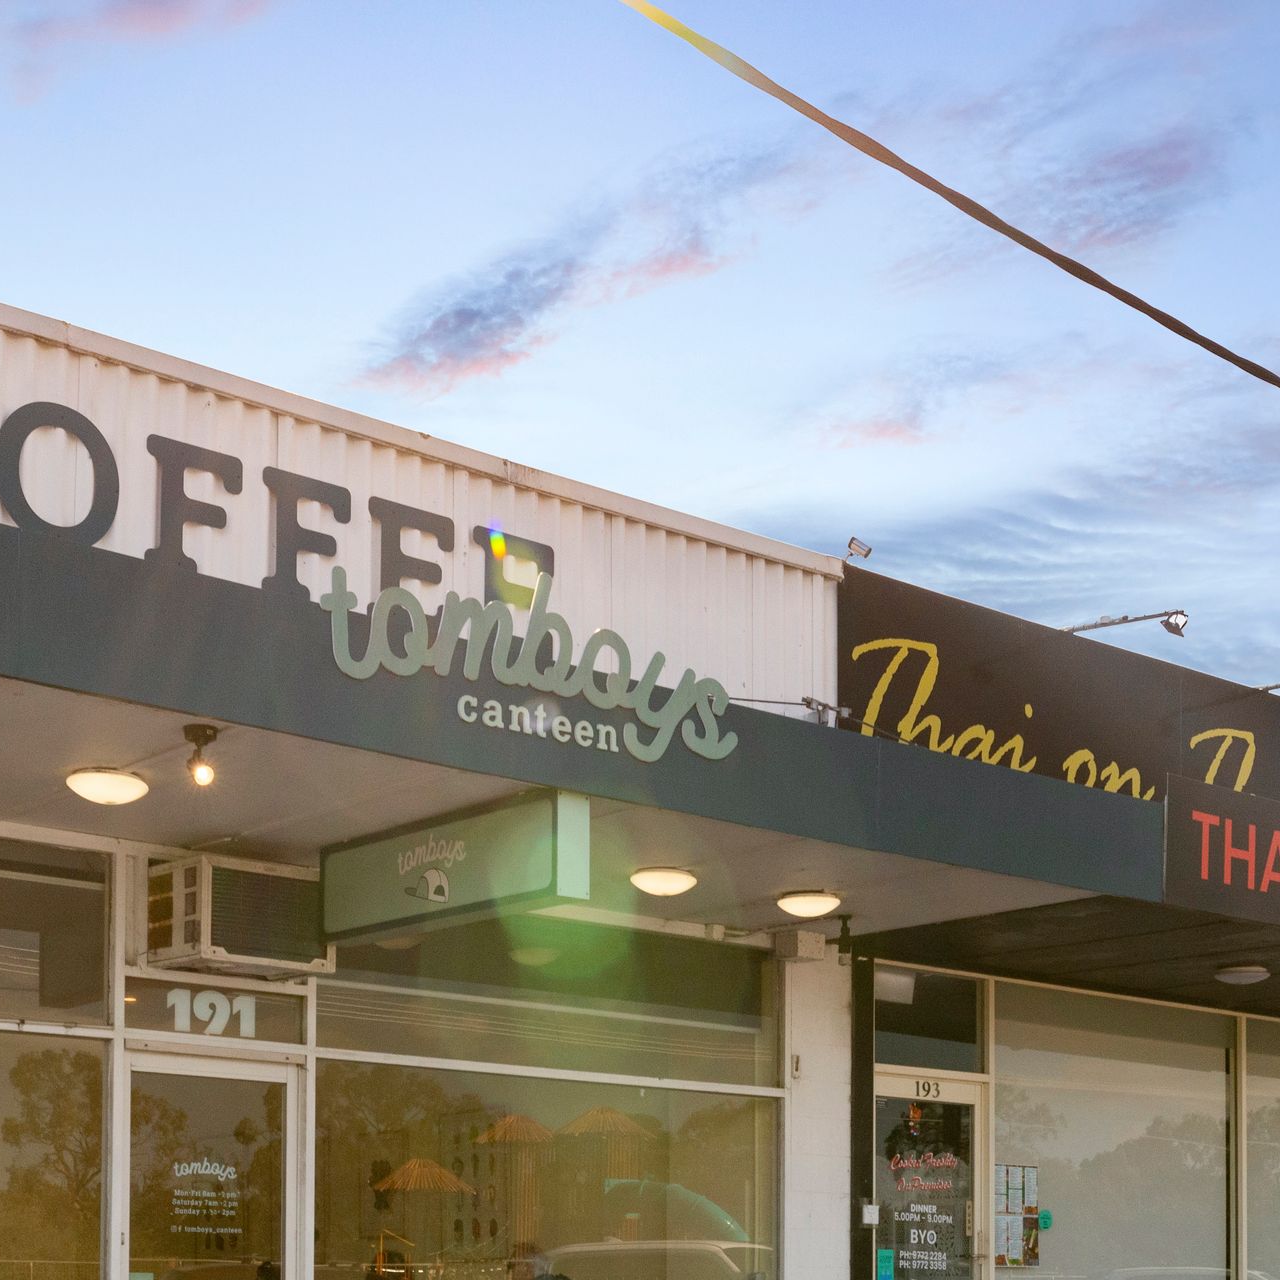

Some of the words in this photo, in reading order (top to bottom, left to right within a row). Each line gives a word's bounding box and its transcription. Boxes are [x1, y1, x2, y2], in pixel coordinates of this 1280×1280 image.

[320, 565, 739, 763] tomboys
[456, 694, 620, 752] canteen
[851, 637, 1037, 773] Thai
[1062, 749, 1156, 801] on
[397, 833, 467, 875] tomboys
[166, 988, 256, 1038] 191
[915, 1081, 940, 1098] 193
[173, 1157, 237, 1181] tomboys
[894, 1212, 921, 1222] 5.00PM
[910, 1204, 937, 1214] DINNER
[910, 1229, 937, 1244] BYO
[899, 1260, 911, 1269] PH:
[912, 1260, 929, 1270] 9772
